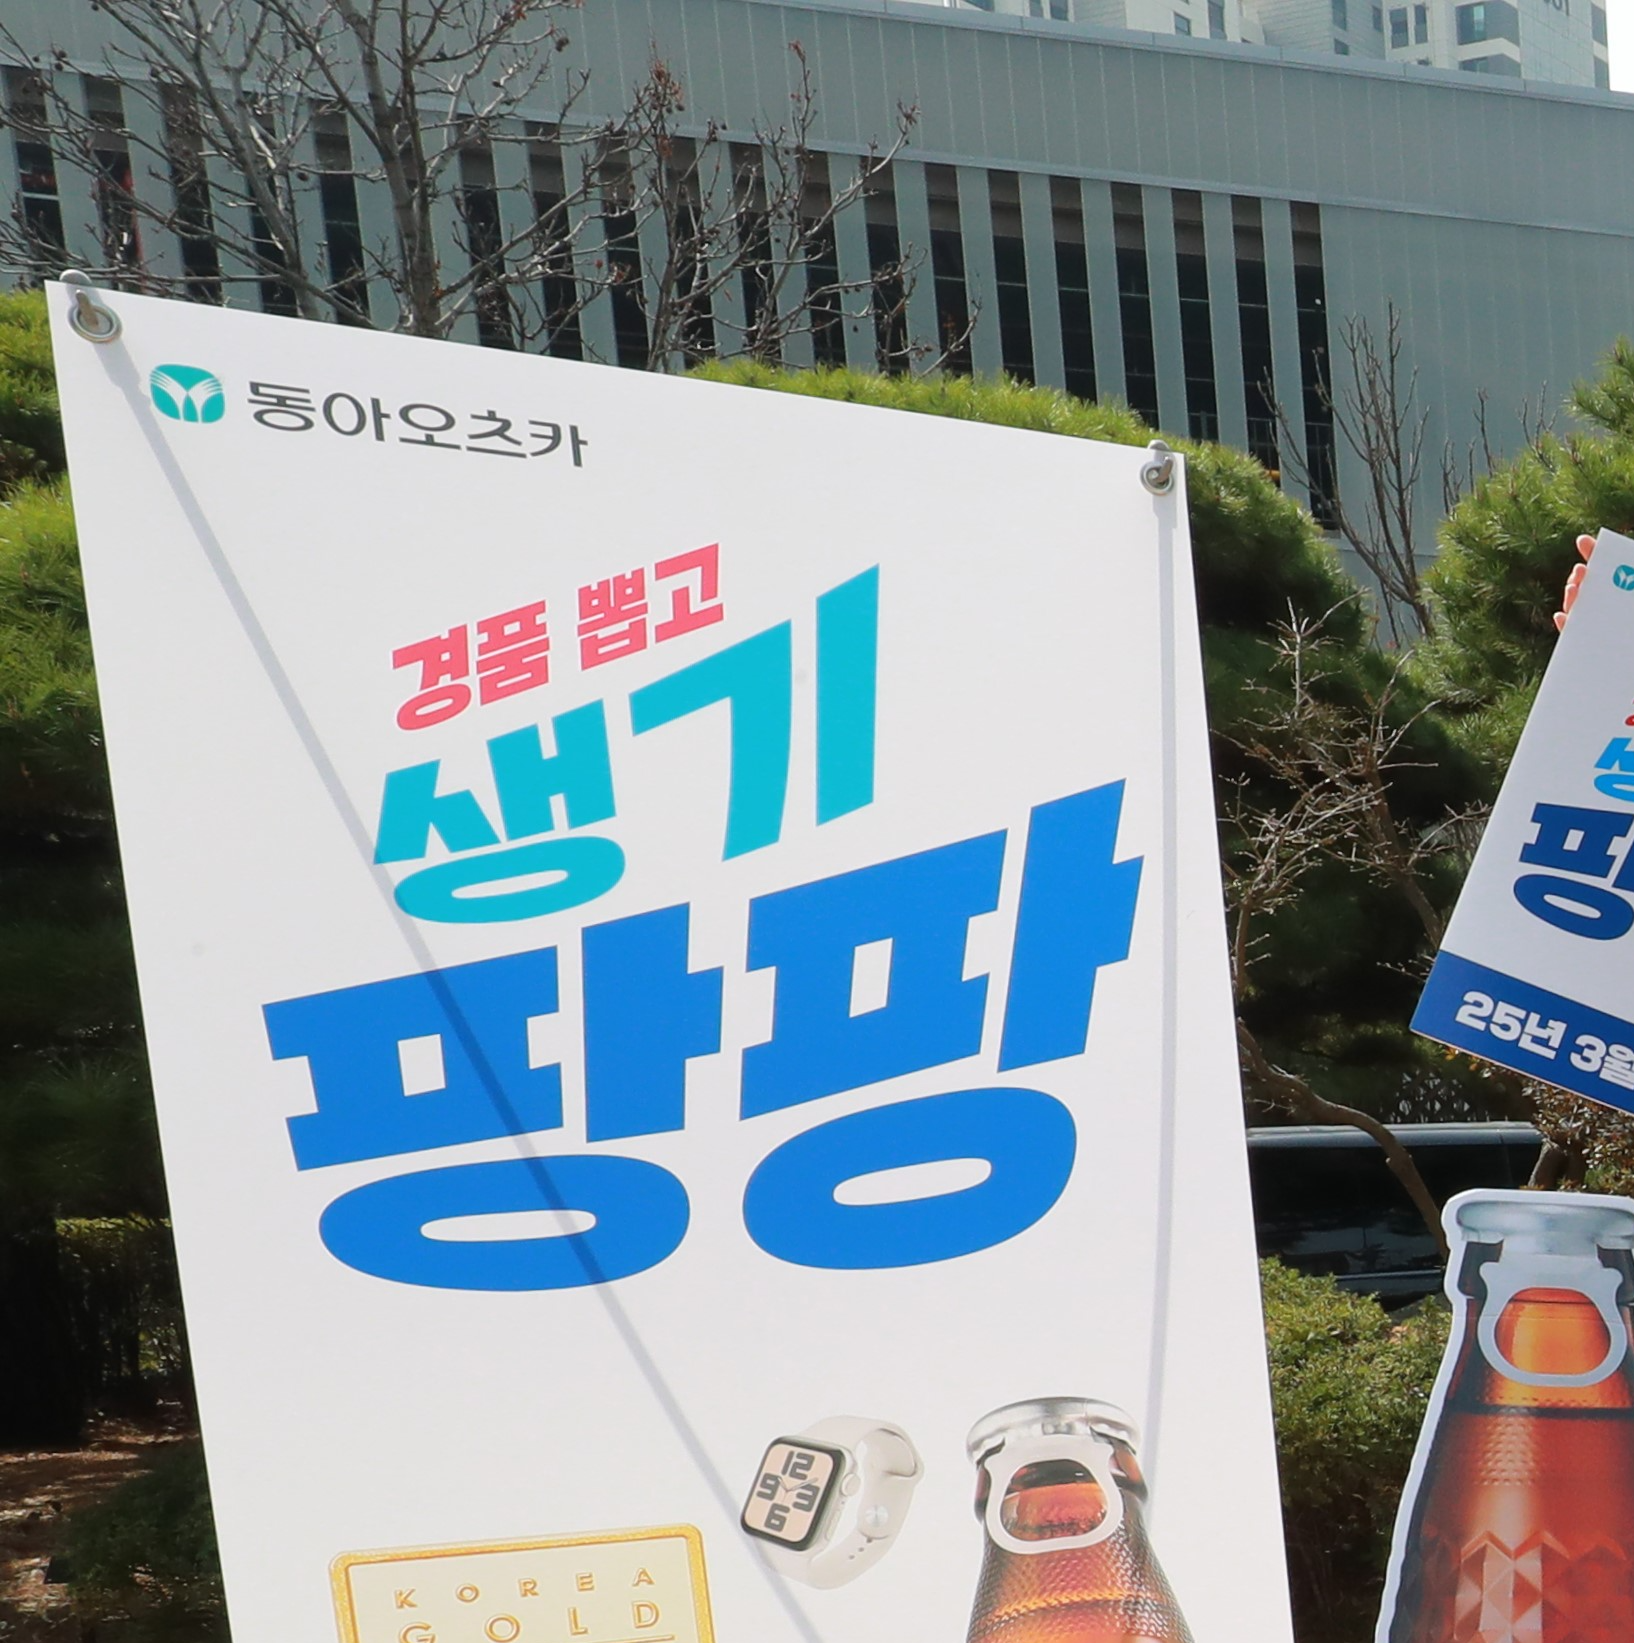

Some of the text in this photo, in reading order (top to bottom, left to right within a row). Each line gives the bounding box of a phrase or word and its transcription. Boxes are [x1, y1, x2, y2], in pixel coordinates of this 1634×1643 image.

[247, 379, 588, 469] 동아오츠카
[392, 542, 724, 731] 경품 뽑고
[373, 563, 880, 924] 생기
[261, 777, 1145, 1292] 팡팡
[1454, 990, 1565, 1062] 25년
[392, 1565, 655, 1610] KOREA
